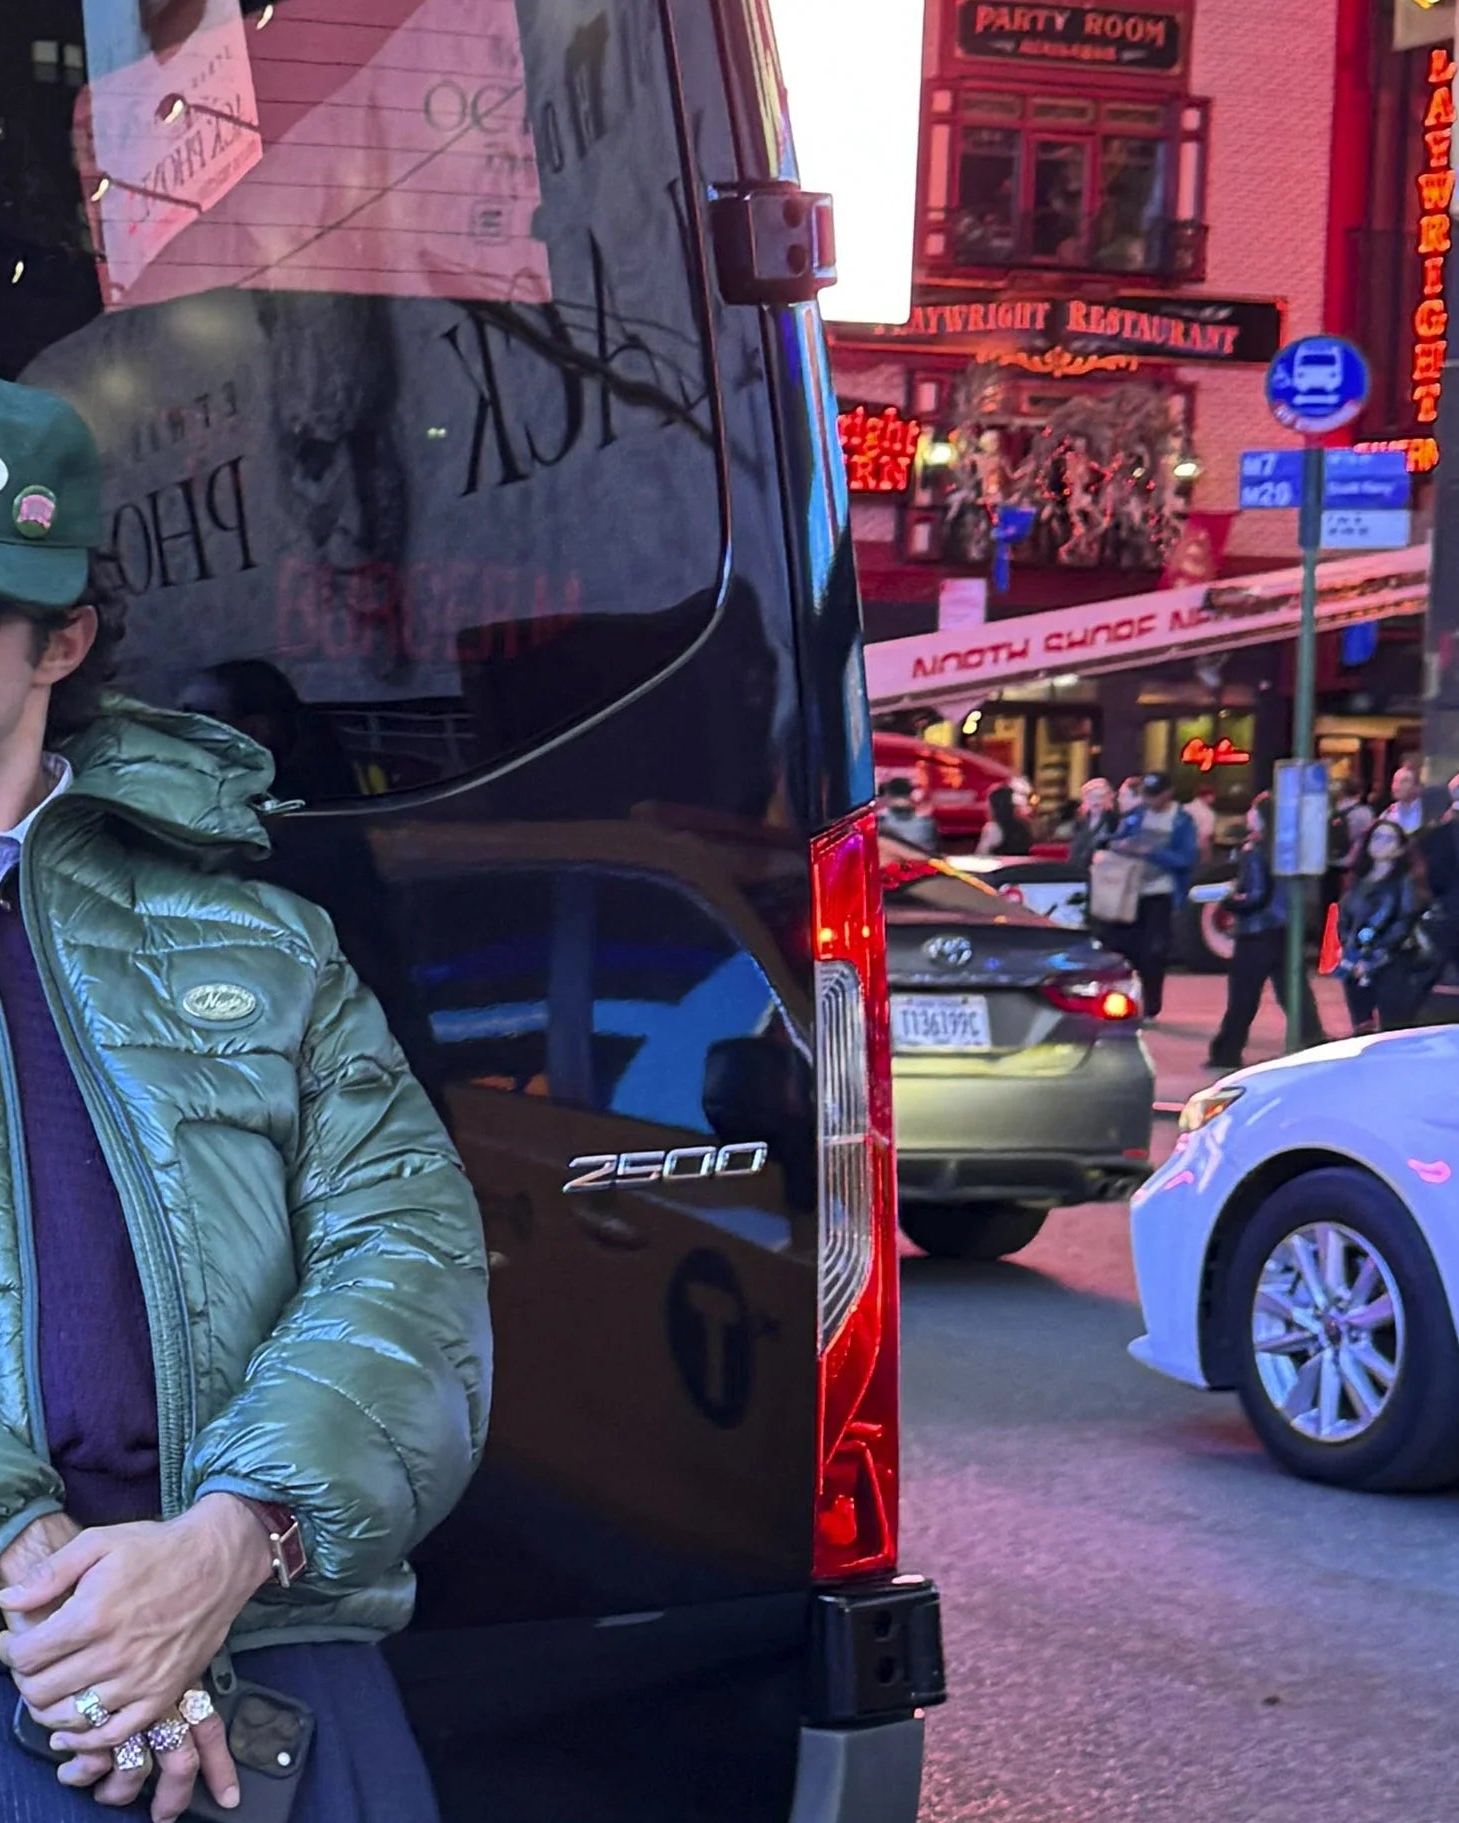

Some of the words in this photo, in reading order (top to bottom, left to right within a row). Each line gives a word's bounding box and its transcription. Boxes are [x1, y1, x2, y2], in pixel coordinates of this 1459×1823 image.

[975, 5, 1070, 33] PARTY
[1084, 13, 1166, 47] ROOM
[874, 301, 1051, 336] AYWRIGHT
[1067, 300, 1240, 354] RESTAURANT
[562, 1141, 768, 1194] 2500
